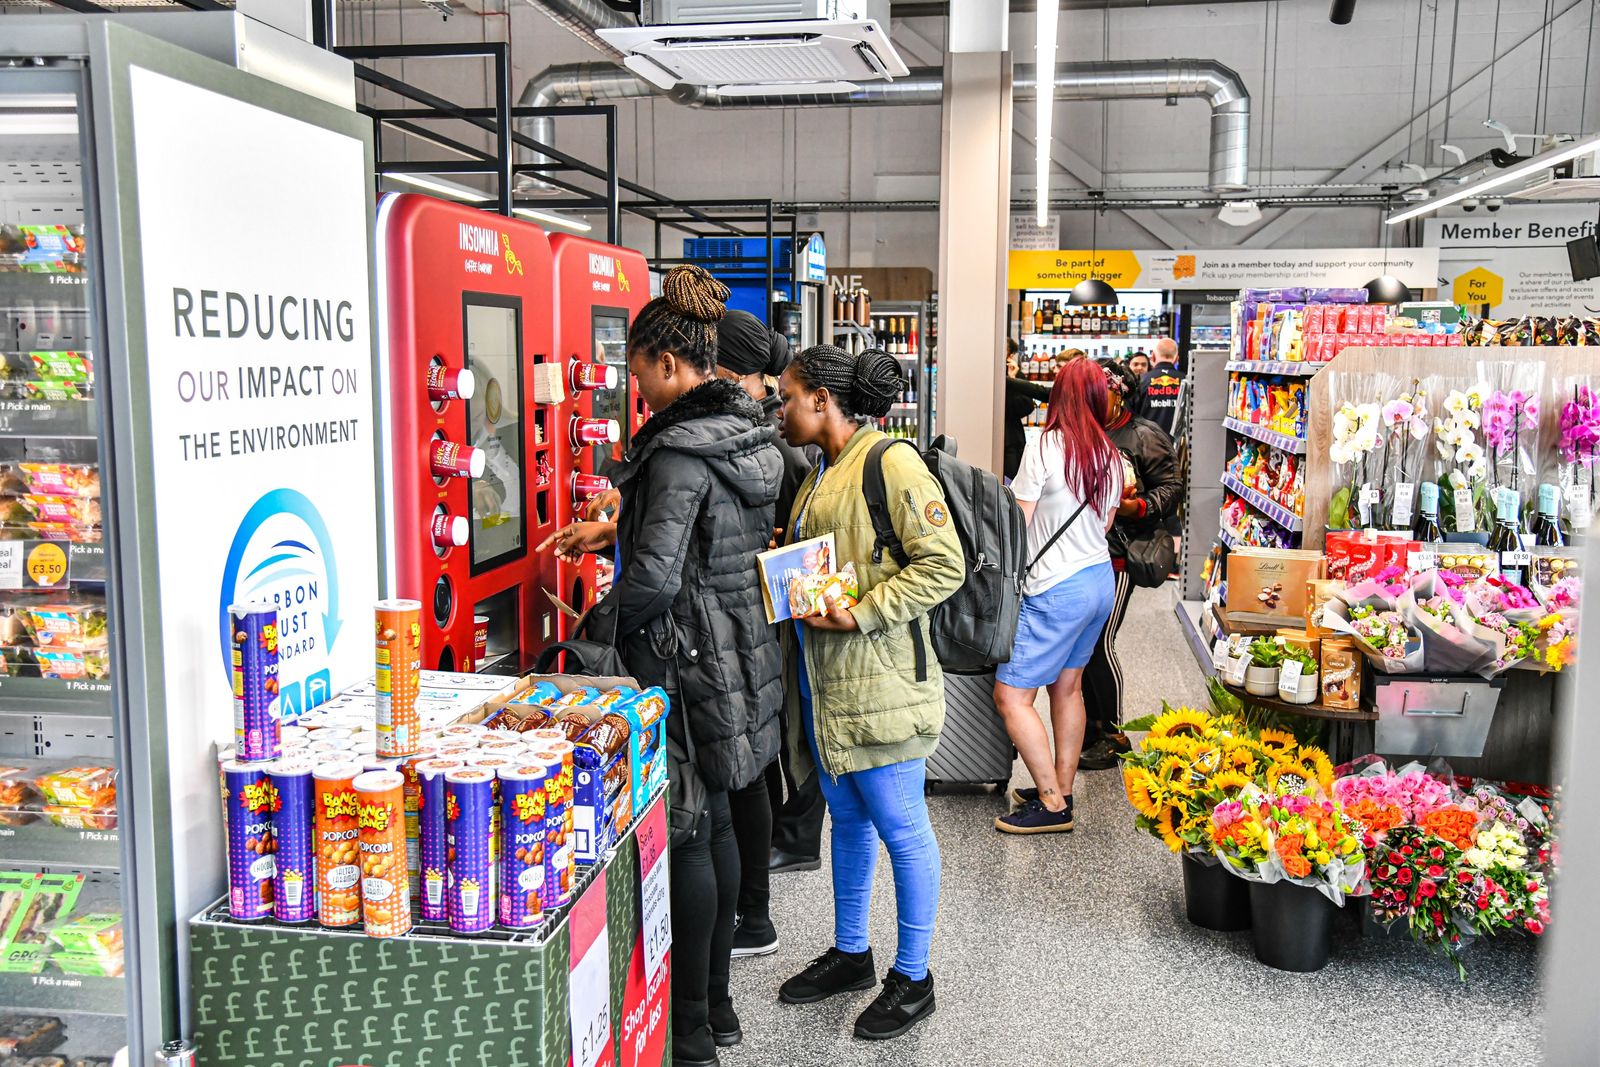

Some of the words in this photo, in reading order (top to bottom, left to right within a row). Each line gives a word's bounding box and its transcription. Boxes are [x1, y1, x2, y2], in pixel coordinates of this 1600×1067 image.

[1441, 221, 1523, 239] Member
[459, 222, 500, 256] INSOMNIA
[1056, 259, 1068, 267] Be
[1071, 259, 1091, 270] part
[1094, 258, 1105, 267] of
[1273, 261, 1296, 270] today
[1315, 260, 1347, 269] support
[1368, 260, 1414, 268] community
[1037, 271, 1087, 282] something
[1090, 271, 1122, 282] bigger
[1249, 271, 1290, 280] membership
[824, 274, 863, 291] INE
[1469, 279, 1486, 288] For
[1467, 292, 1487, 301] You
[173, 287, 355, 342] REDUCING
[178, 370, 230, 403] OUR
[238, 365, 325, 399] IMPACT
[332, 368, 358, 395] ON
[1147, 386, 1165, 396] Red
[7, 402, 23, 411] Pick
[31, 403, 51, 411] main
[1150, 399, 1171, 408] Mobil
[179, 433, 222, 462] THE
[230, 418, 358, 456] ENVIRONMENT
[32, 564, 62, 574] £3.50
[1258, 561, 1280, 571] Lindt
[73, 682, 89, 691] Pick
[86, 832, 102, 841] Pick
[322, 830, 358, 841] POPCOR
[639, 826, 654, 851] Save
[358, 842, 393, 854] OPCORN
[650, 912, 669, 962] £1.50
[39, 977, 55, 986] Pick
[62, 978, 82, 987] main
[624, 998, 645, 1041] Shop
[581, 1002, 608, 1066] £1.25
[634, 1023, 648, 1067] for
[648, 997, 662, 1036] less
